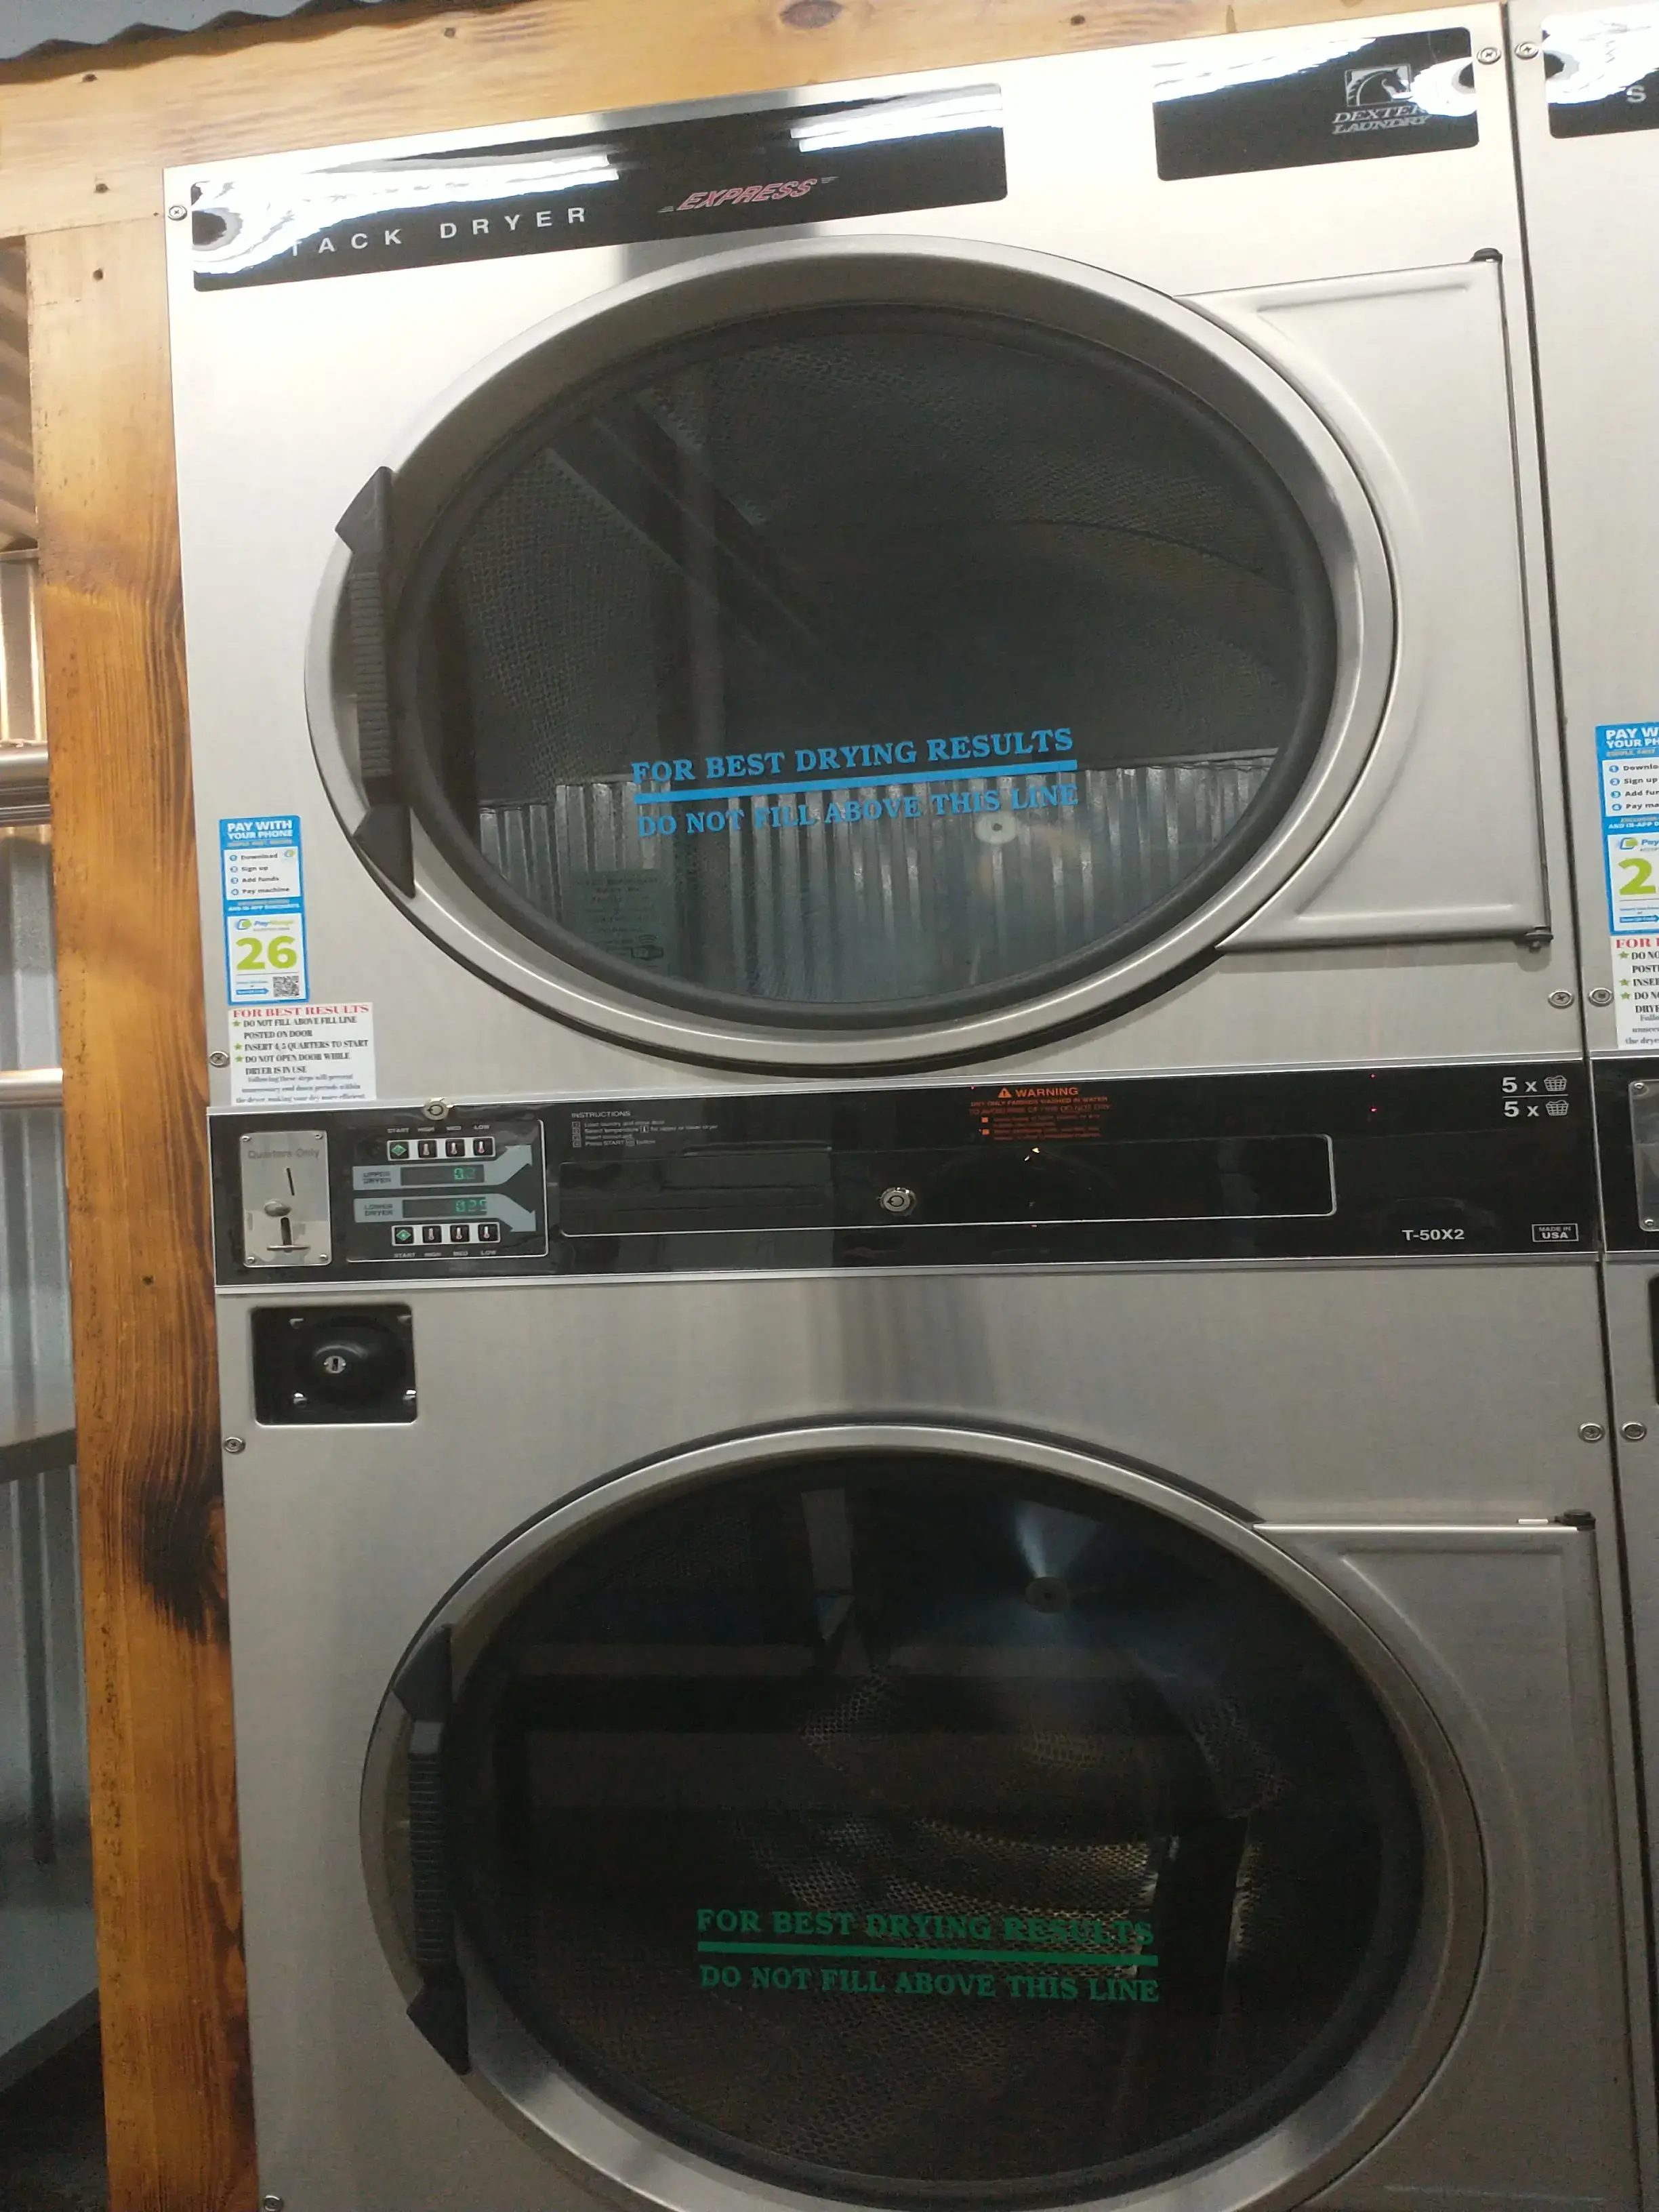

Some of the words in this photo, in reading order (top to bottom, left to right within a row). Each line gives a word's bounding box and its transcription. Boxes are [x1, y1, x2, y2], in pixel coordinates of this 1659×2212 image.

[1332, 115, 1432, 135] LAUNDRY
[676, 178, 818, 211] EXPRESS
[441, 207, 586, 239] DRYER
[1605, 728, 1637, 740] PAY
[1605, 739, 1642, 749] YOUR
[631, 759, 696, 784] FOR
[705, 752, 785, 779] BEST
[795, 741, 917, 772] DRYING
[926, 727, 1074, 762] RESULTS
[1624, 777, 1643, 785] Sign
[638, 815, 677, 838] DO
[686, 809, 745, 834] NOT
[754, 804, 818, 830] FILL
[825, 796, 922, 824] ABOVE
[929, 790, 1001, 816] THIS
[1010, 783, 1079, 811] LINE
[227, 822, 253, 832] PAY
[255, 819, 293, 831] WITH
[227, 832, 256, 840] YOUR
[258, 829, 293, 839] PHONE
[1616, 938, 1652, 949] FOR
[235, 935, 298, 971] 26
[1631, 951, 1645, 960] DO
[1634, 991, 1649, 1000] DO
[233, 1008, 262, 1018] FOR
[266, 1007, 302, 1017] BEST
[305, 1004, 369, 1015] RESULTS
[274, 1018, 291, 1026] FILL
[293, 1017, 319, 1025] ABOVE
[321, 1017, 337, 1025] FILL
[339, 1016, 357, 1024] LINE
[245, 1043, 273, 1051] INSERT
[287, 1041, 330, 1051] QUARTERS
[258, 1054, 275, 1063] NOT
[276, 1054, 297, 1062] OPEN
[298, 1053, 323, 1061] DOOR
[245, 1067, 272, 1075] DRYER
[292, 1065, 307, 1073] USE
[1502, 1077, 1518, 1093] 5
[1015, 1087, 1079, 1097] WARNING
[571, 1110, 631, 1118] INSTRUCTIONS
[1503, 1101, 1520, 1118] 5
[1401, 1228, 1465, 1241] T-50X2
[697, 1908, 763, 1933] FOR
[771, 1910, 855, 1935] BEST
[865, 1913, 992, 1941] DRYING
[1002, 1917, 1154, 1945] RESULTS
[699, 1965, 742, 1989] DO
[750, 1966, 813, 1990] NOT
[820, 1967, 885, 1993] FILL
[894, 1970, 997, 1998] ABOVE
[1005, 1974, 1079, 1999] THIS
[1088, 1977, 1160, 2002] LINE
